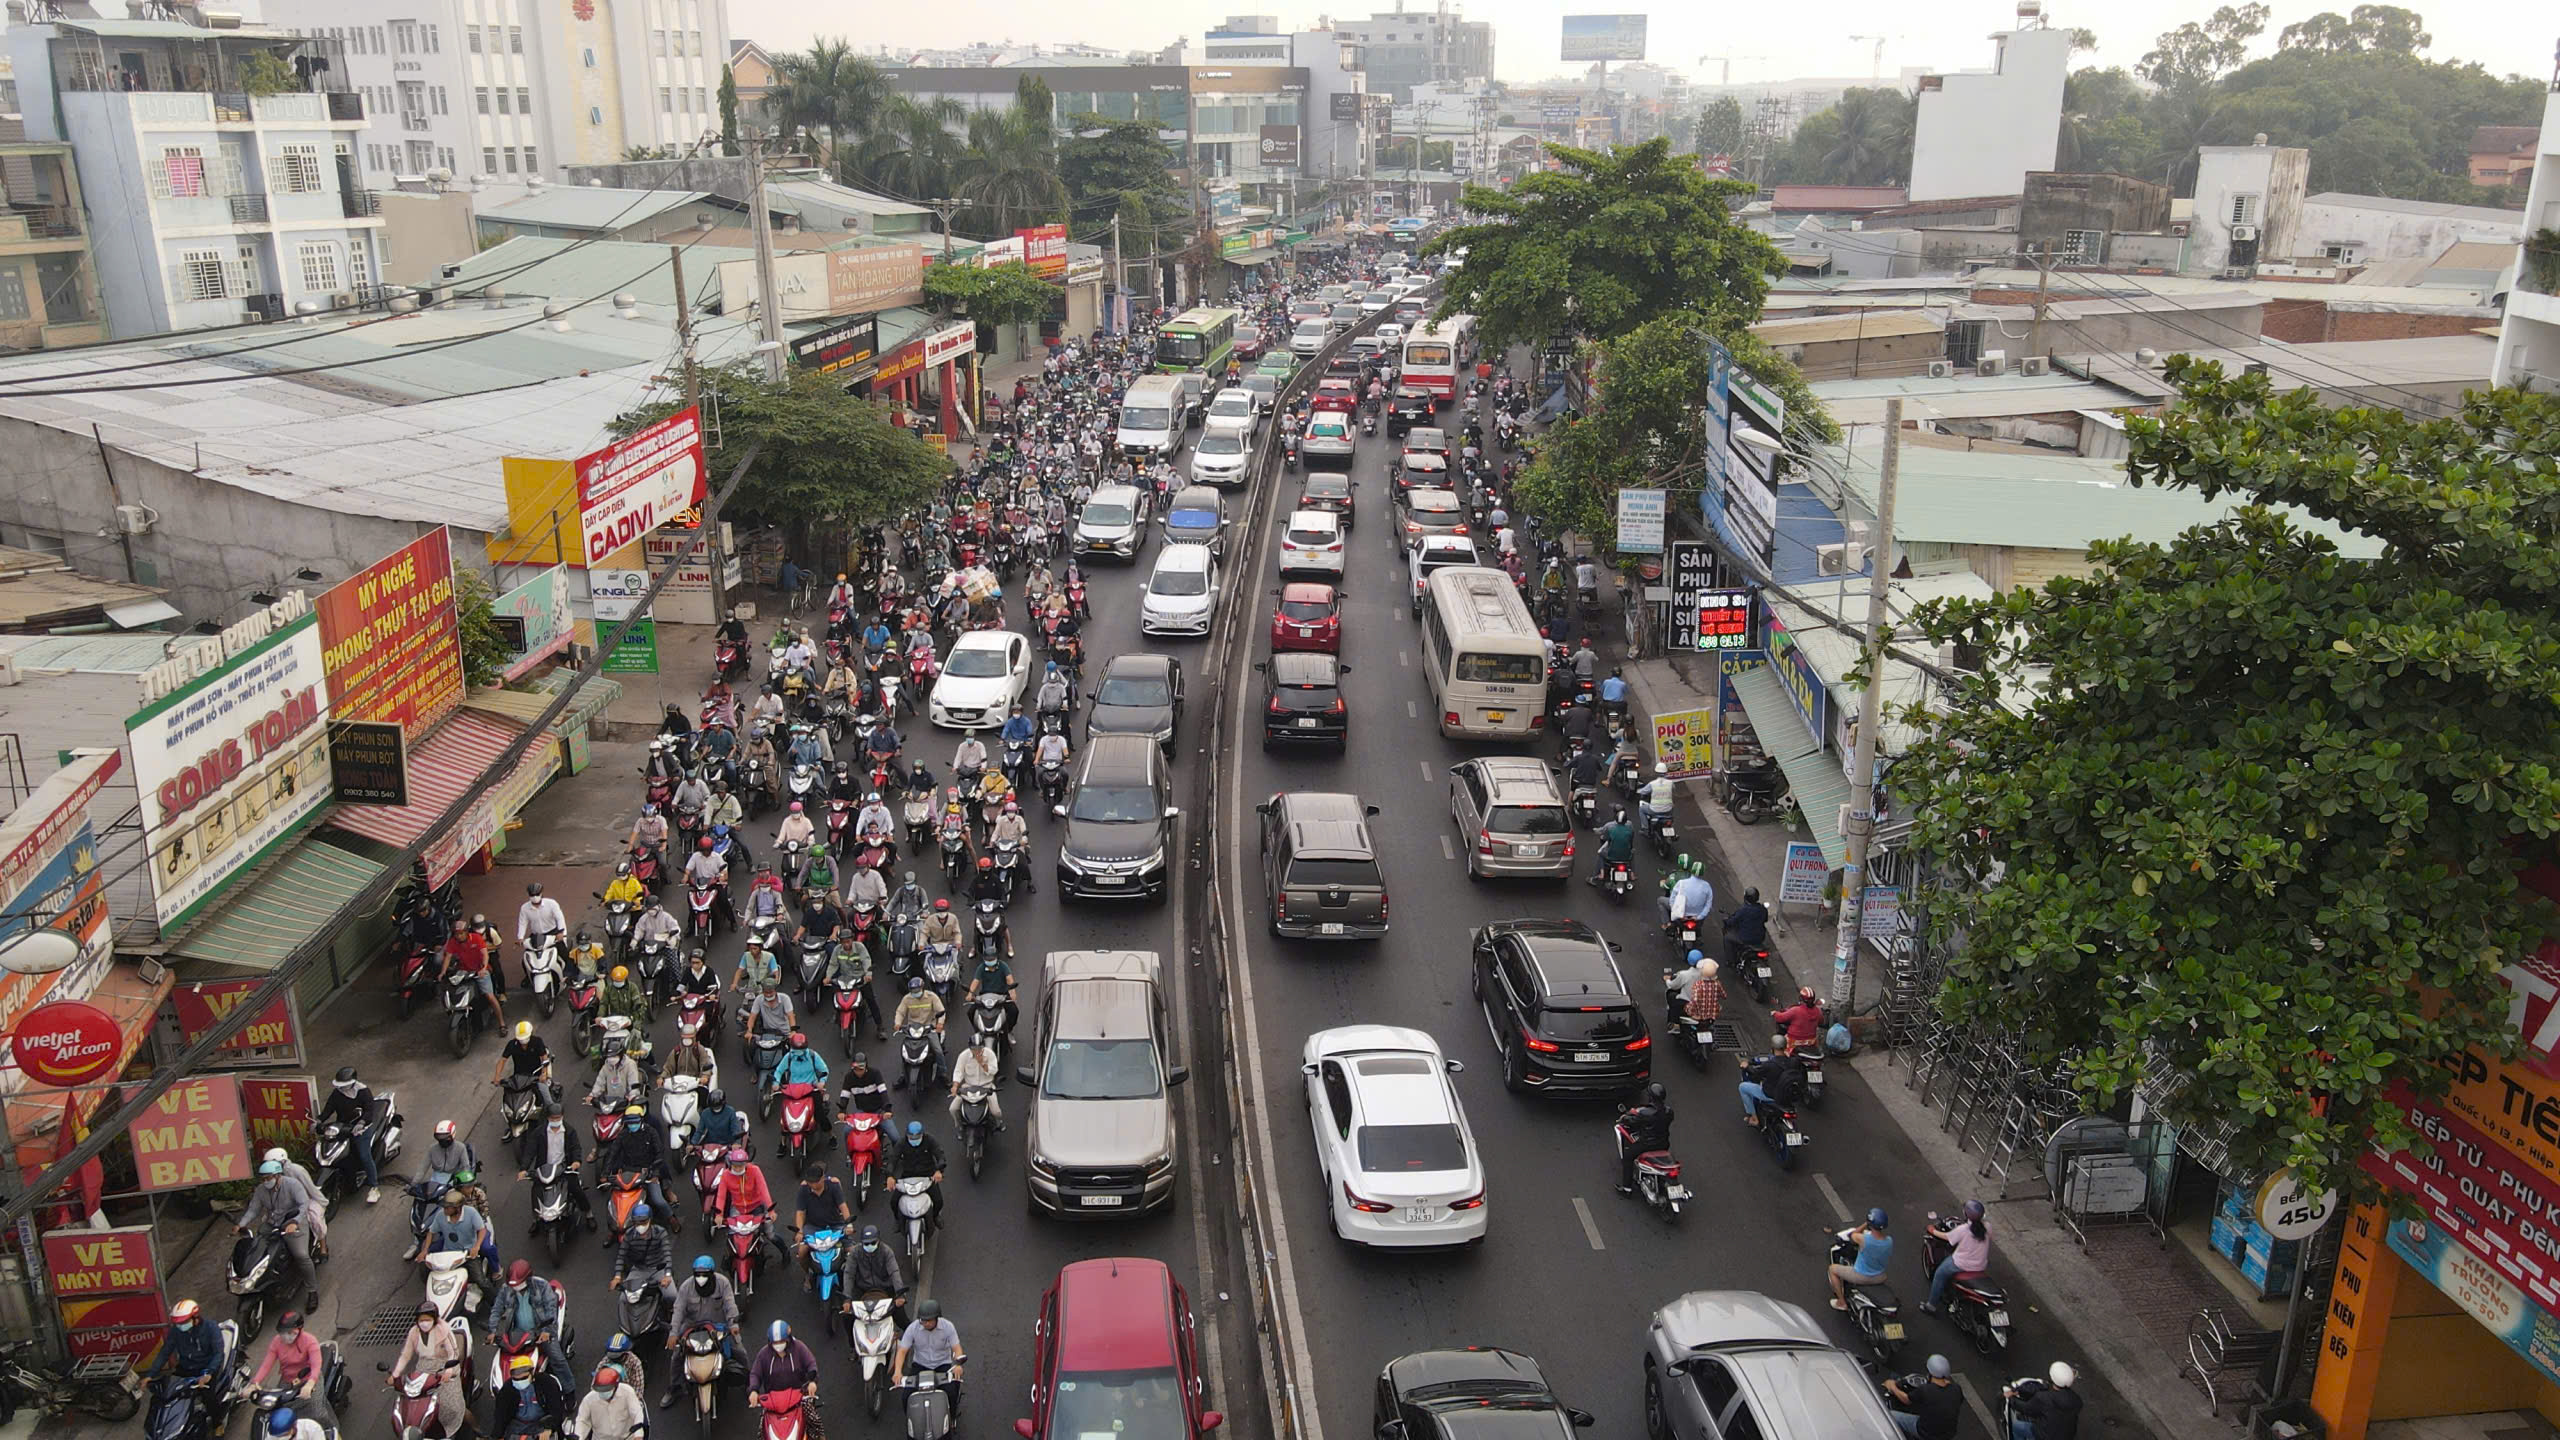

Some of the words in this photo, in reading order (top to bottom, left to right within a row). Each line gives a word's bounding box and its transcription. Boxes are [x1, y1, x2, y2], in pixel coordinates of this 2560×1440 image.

[590, 501, 654, 562] CADIVI
[1680, 548, 1712, 568] SẢN
[358, 570, 378, 612] MỸ
[380, 552, 416, 598] NGHỆ
[679, 573, 710, 582] LINH
[221, 607, 273, 658] PHUN
[324, 625, 374, 677] PHONG
[410, 588, 431, 622] TẠI
[431, 575, 453, 606] GIA
[624, 635, 646, 644] LINH
[167, 711, 185, 730] MÁY
[186, 697, 206, 717] PHUN
[244, 666, 262, 683] PHUN
[185, 718, 205, 739] PHUN
[353, 733, 375, 746] PHUN
[376, 732, 395, 747] SƠN
[1690, 734, 1711, 747] 30K
[157, 739, 243, 829] SONG
[245, 688, 319, 764] TOÀN
[336, 749, 354, 763] MÁY
[355, 751, 377, 764] PHUN
[1689, 760, 1710, 770] 30K
[343, 788, 363, 797] 0902
[380, 790, 396, 799] 540
[246, 1021, 286, 1046] BAY
[156, 1079, 213, 1116] VÉ
[261, 1083, 295, 1111] VÉ
[137, 1118, 236, 1154] MÁY
[253, 1113, 310, 1141] MÁY
[2452, 1095, 2480, 1120] Quốc
[2481, 1114, 2496, 1132] Lộ
[2529, 1146, 2555, 1170] Hiệp
[150, 1153, 236, 1188] BAY
[2410, 1108, 2450, 1143] BẾP
[2456, 1138, 2484, 1168] TỪ
[2499, 1169, 2543, 1216] PHỤ
[2277, 1203, 2327, 1227] 450
[2459, 1177, 2516, 1226] QUẠT
[72, 1237, 125, 1267] VÉ
[57, 1268, 103, 1290] MÁY
[109, 1267, 148, 1288] BAY
[2341, 1265, 2362, 1297] PHỤ
[2457, 1284, 2473, 1305] 10
[2333, 1298, 2356, 1330] KIỆN
[2329, 1333, 2349, 1361] BẾP
